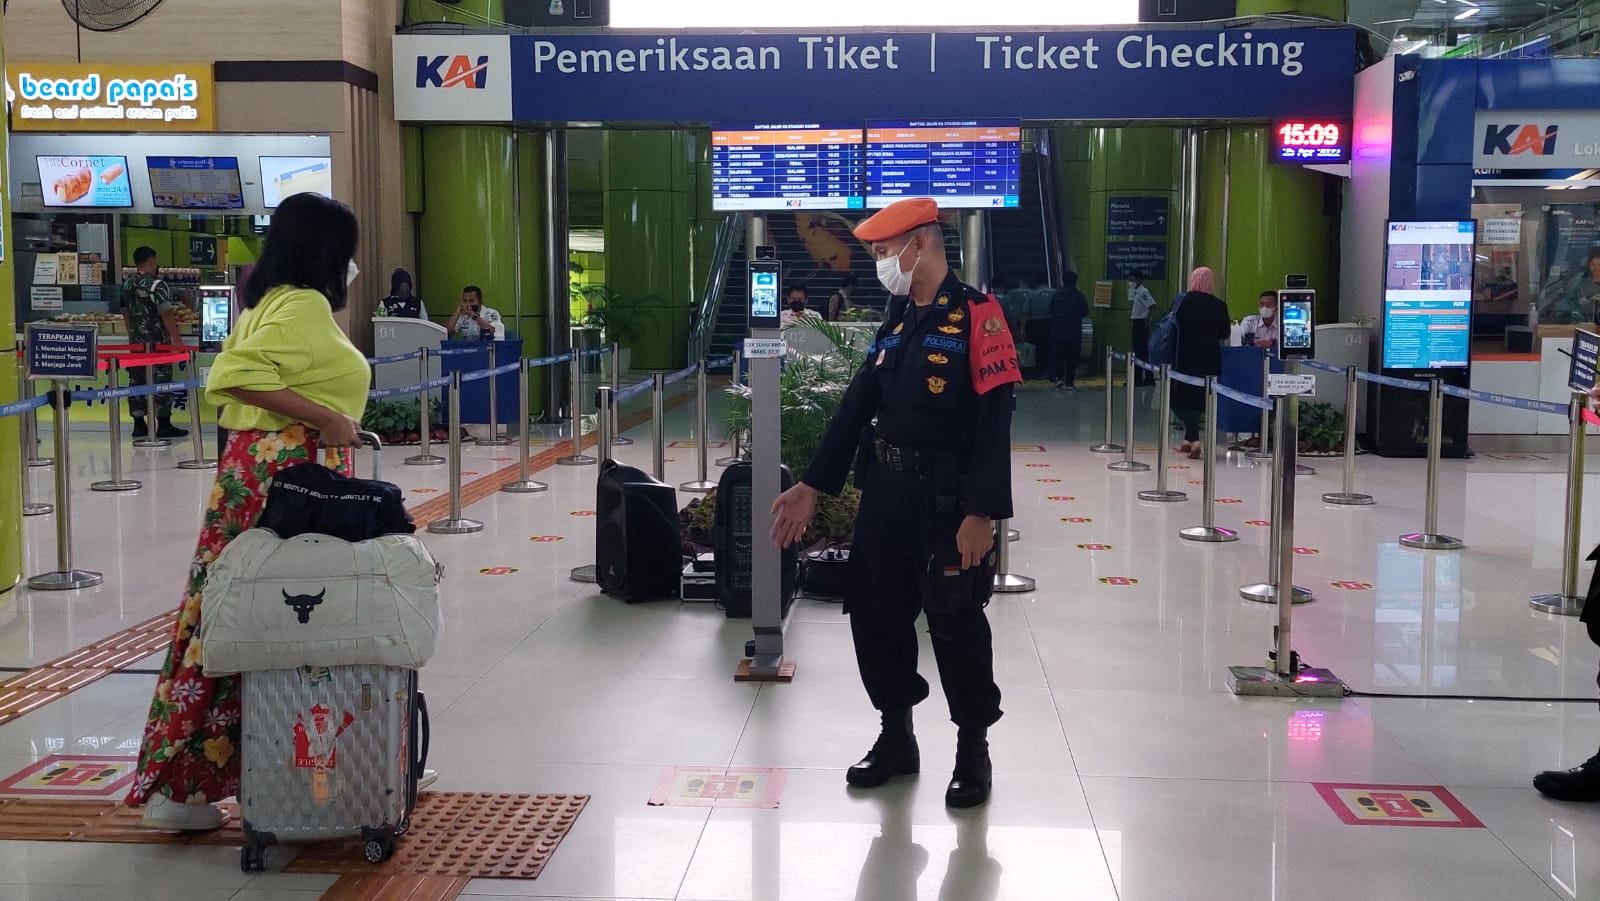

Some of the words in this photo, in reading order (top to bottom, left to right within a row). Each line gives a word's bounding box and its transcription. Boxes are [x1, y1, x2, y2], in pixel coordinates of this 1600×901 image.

[534, 38, 781, 74] Pemeriksaan
[798, 36, 899, 71] Tiket
[975, 34, 1100, 70] Ticket
[1116, 32, 1305, 76] Checking
[415, 55, 489, 89] KAI
[19, 74, 100, 100] beard
[107, 75, 197, 105] papa's
[22, 105, 52, 119] fresh
[54, 106, 79, 119] and
[80, 106, 124, 119] natural
[126, 106, 163, 119] cream
[165, 106, 197, 121] puffs
[1280, 123, 1339, 146] 15:09
[1482, 124, 1559, 156] KAI
[60, 156, 105, 168] Cornet
[1391, 224, 1407, 232] KAI
[38, 333, 74, 341] TERAPKAN
[379, 326, 396, 339] 01
[790, 331, 806, 343] 02
[925, 334, 964, 351] POLSUSKA
[979, 359, 1007, 381] PAM
